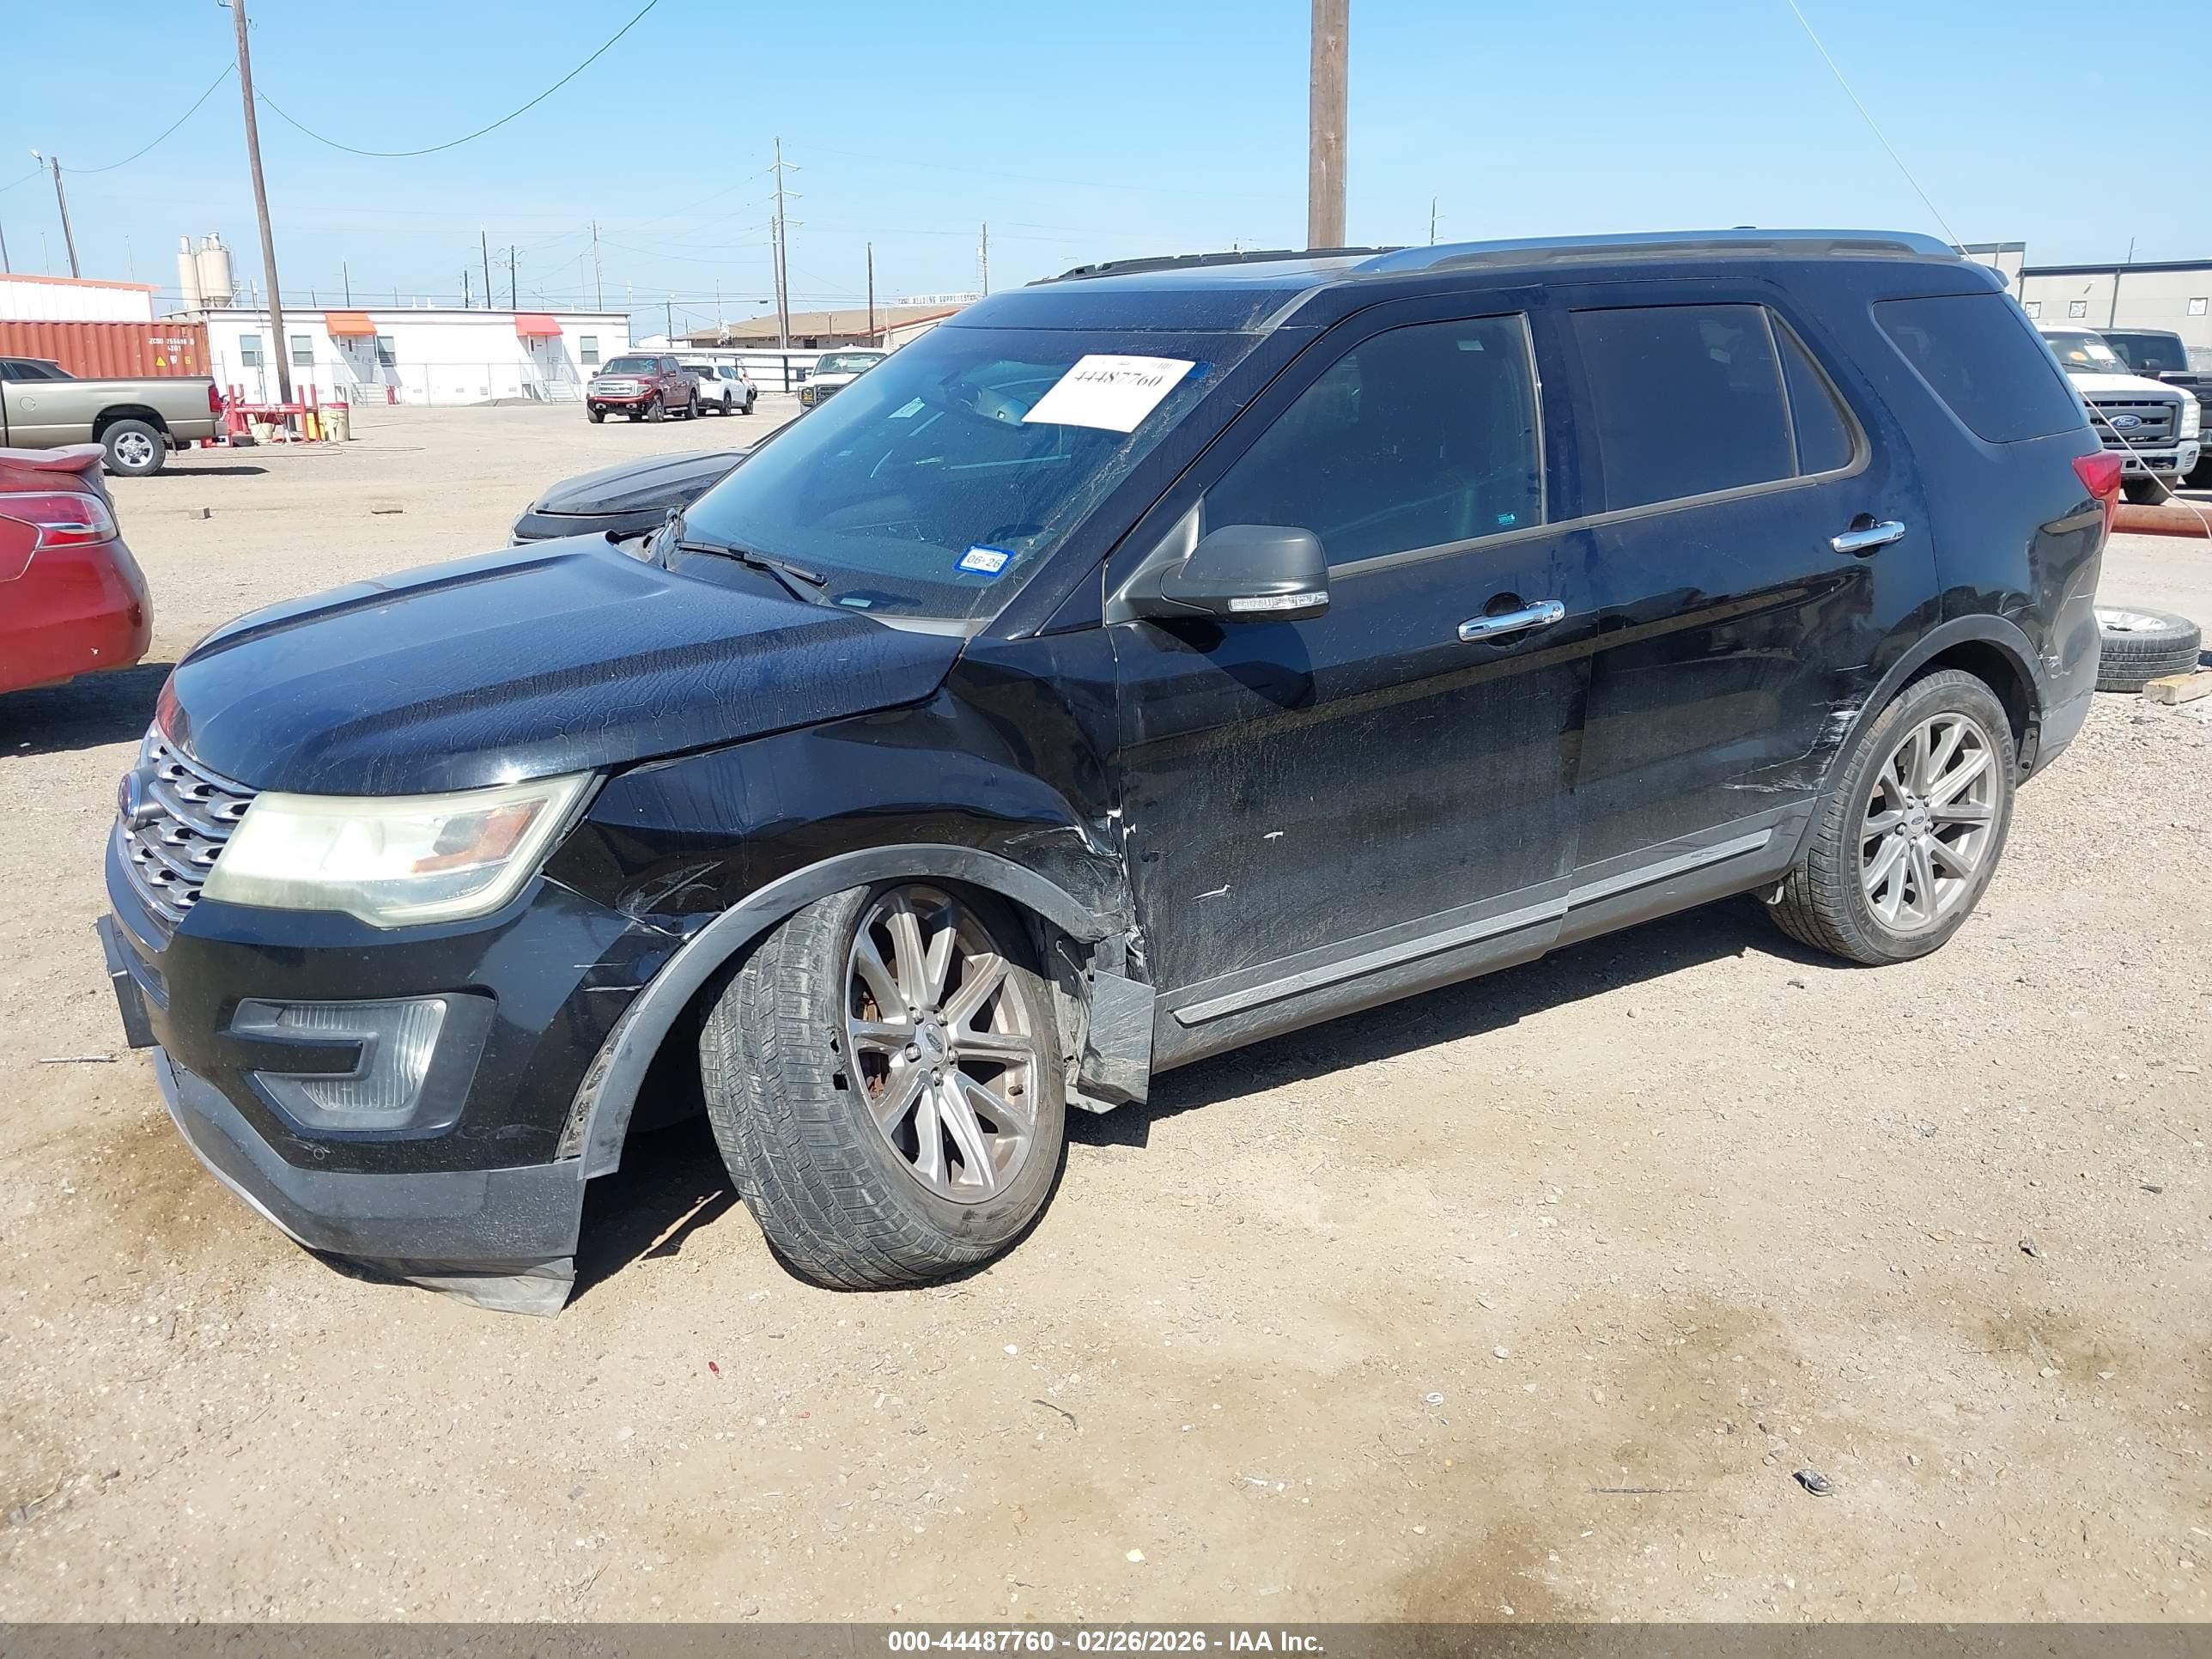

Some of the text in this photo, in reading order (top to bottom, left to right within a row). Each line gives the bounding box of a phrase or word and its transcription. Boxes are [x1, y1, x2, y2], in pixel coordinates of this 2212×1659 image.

[1073, 369, 1164, 387] 44487760
[2117, 417, 2136, 427] Ford
[967, 554, 1003, 568] 06 26
